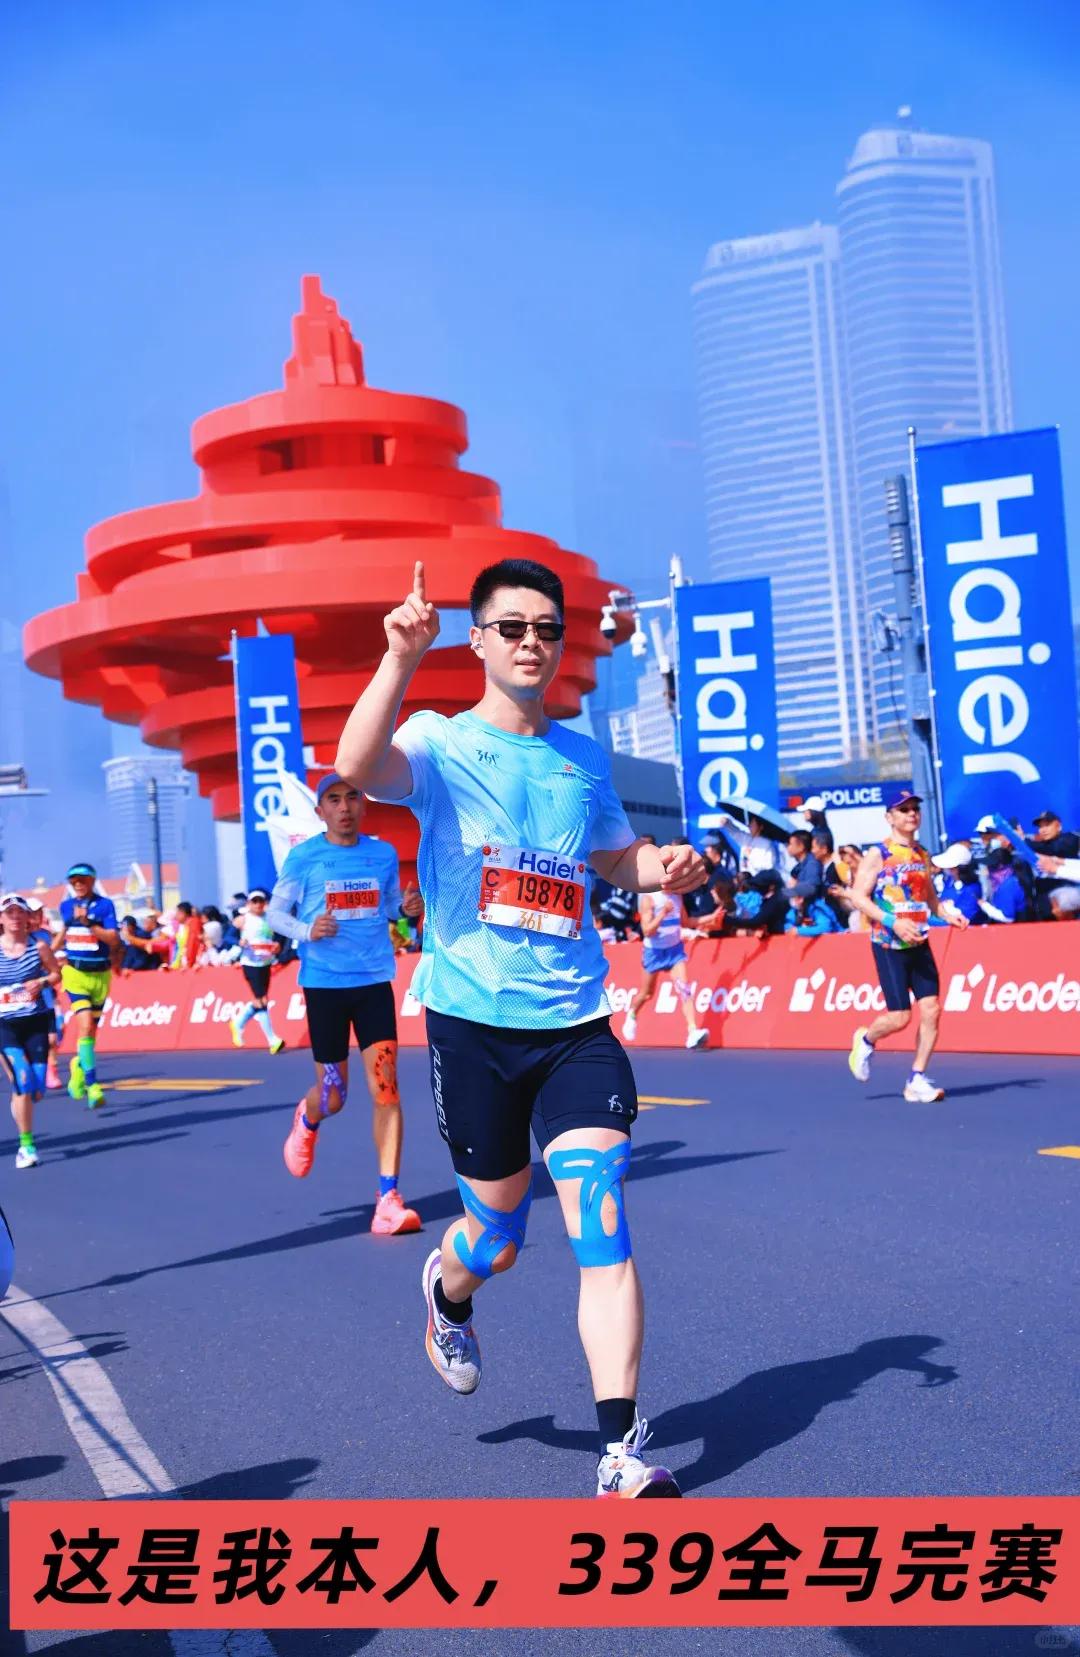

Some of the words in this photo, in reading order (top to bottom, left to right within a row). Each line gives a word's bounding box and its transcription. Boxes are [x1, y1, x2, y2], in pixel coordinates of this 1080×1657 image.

[942, 474, 1050, 784] Haier
[821, 787, 882, 805] POLICE
[519, 851, 576, 881] Haier
[343, 881, 372, 891] Haier
[485, 868, 500, 888] C
[516, 875, 575, 911] 19878
[983, 973, 1080, 1012] Leade
[110, 1000, 177, 1028] Leader
